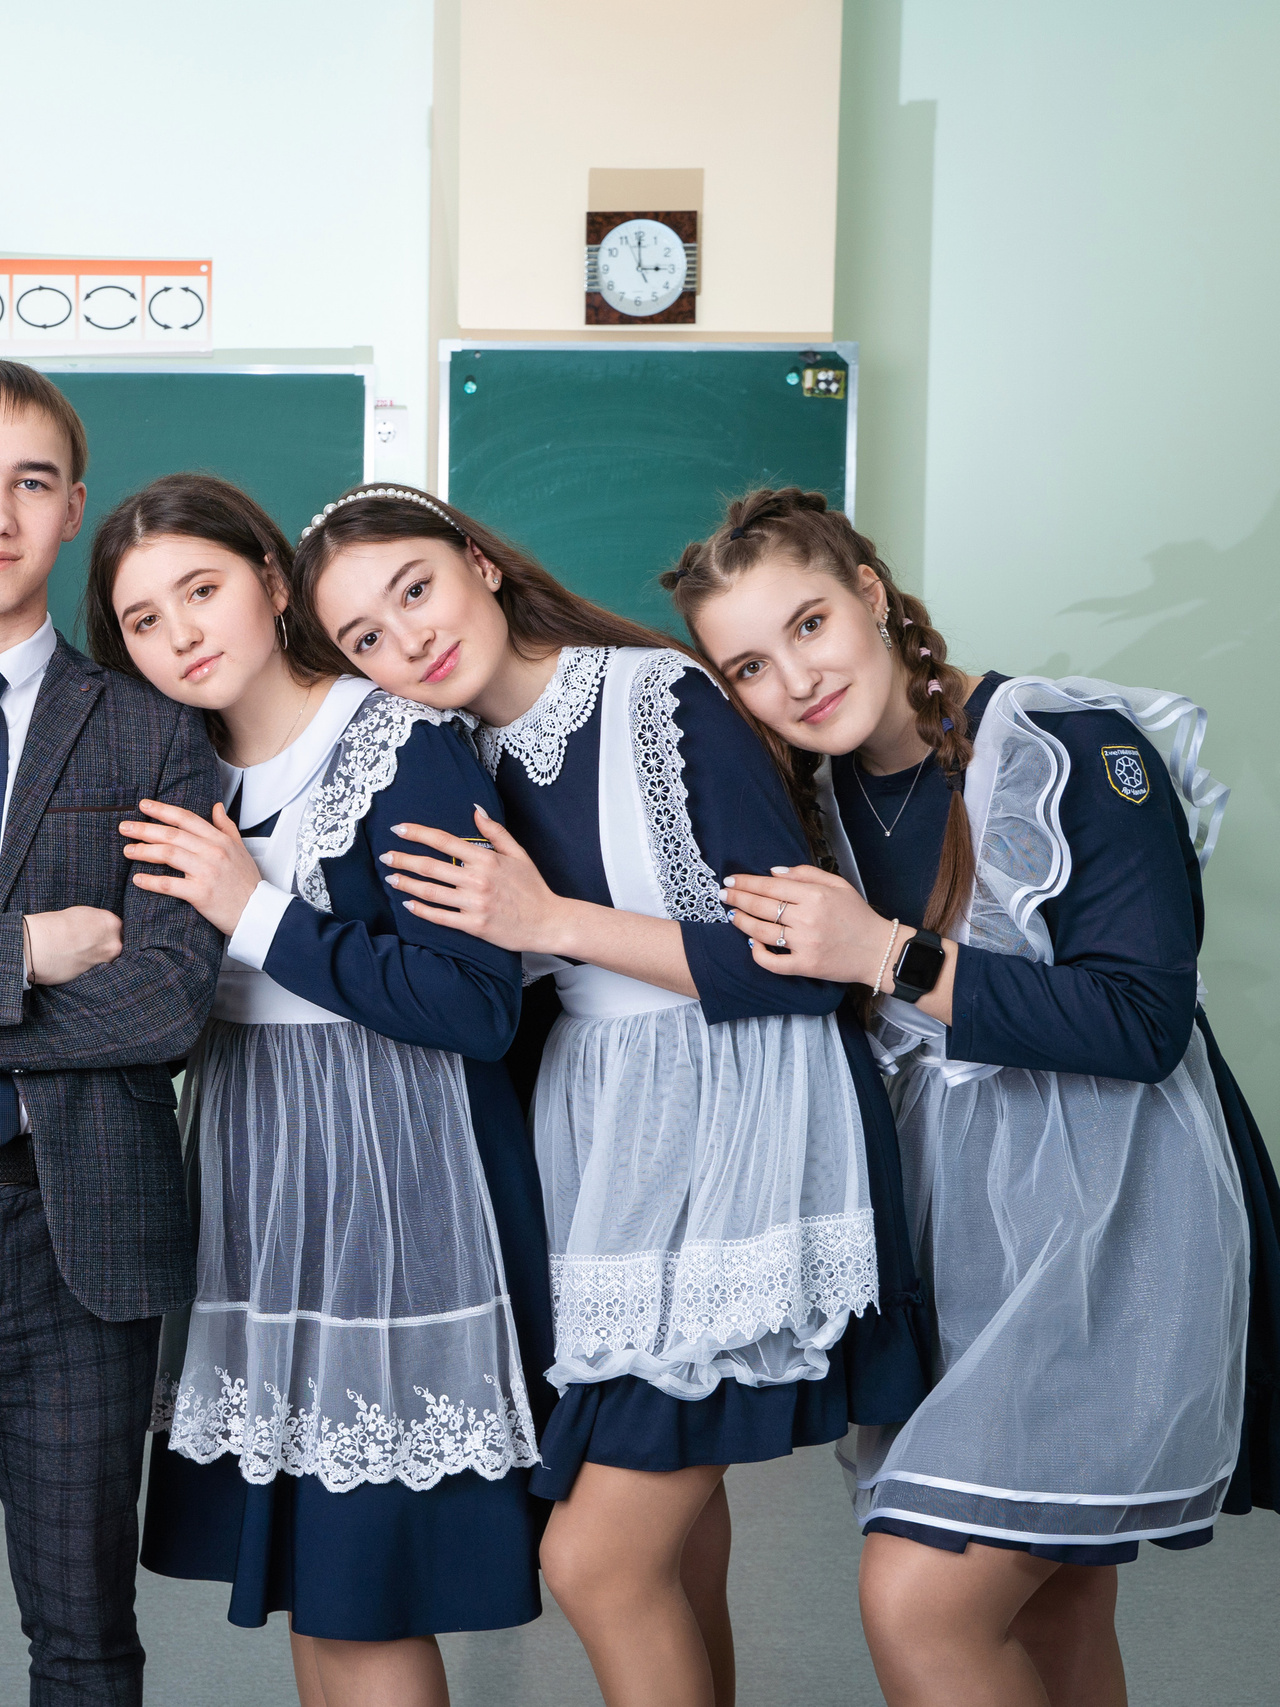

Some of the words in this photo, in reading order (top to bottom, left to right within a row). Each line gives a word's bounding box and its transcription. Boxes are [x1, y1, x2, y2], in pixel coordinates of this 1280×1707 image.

[620, 236, 628, 245] 11
[634, 231, 645, 241] 12
[653, 236, 657, 245] 1
[608, 247, 618, 257] 10
[664, 247, 671, 257] 2
[602, 264, 609, 274] 9
[668, 264, 675, 274] 3
[607, 280, 614, 290] 8
[663, 281, 669, 289] 4
[619, 292, 625, 301] 7
[634, 296, 641, 306] 6
[652, 292, 658, 302] 5
